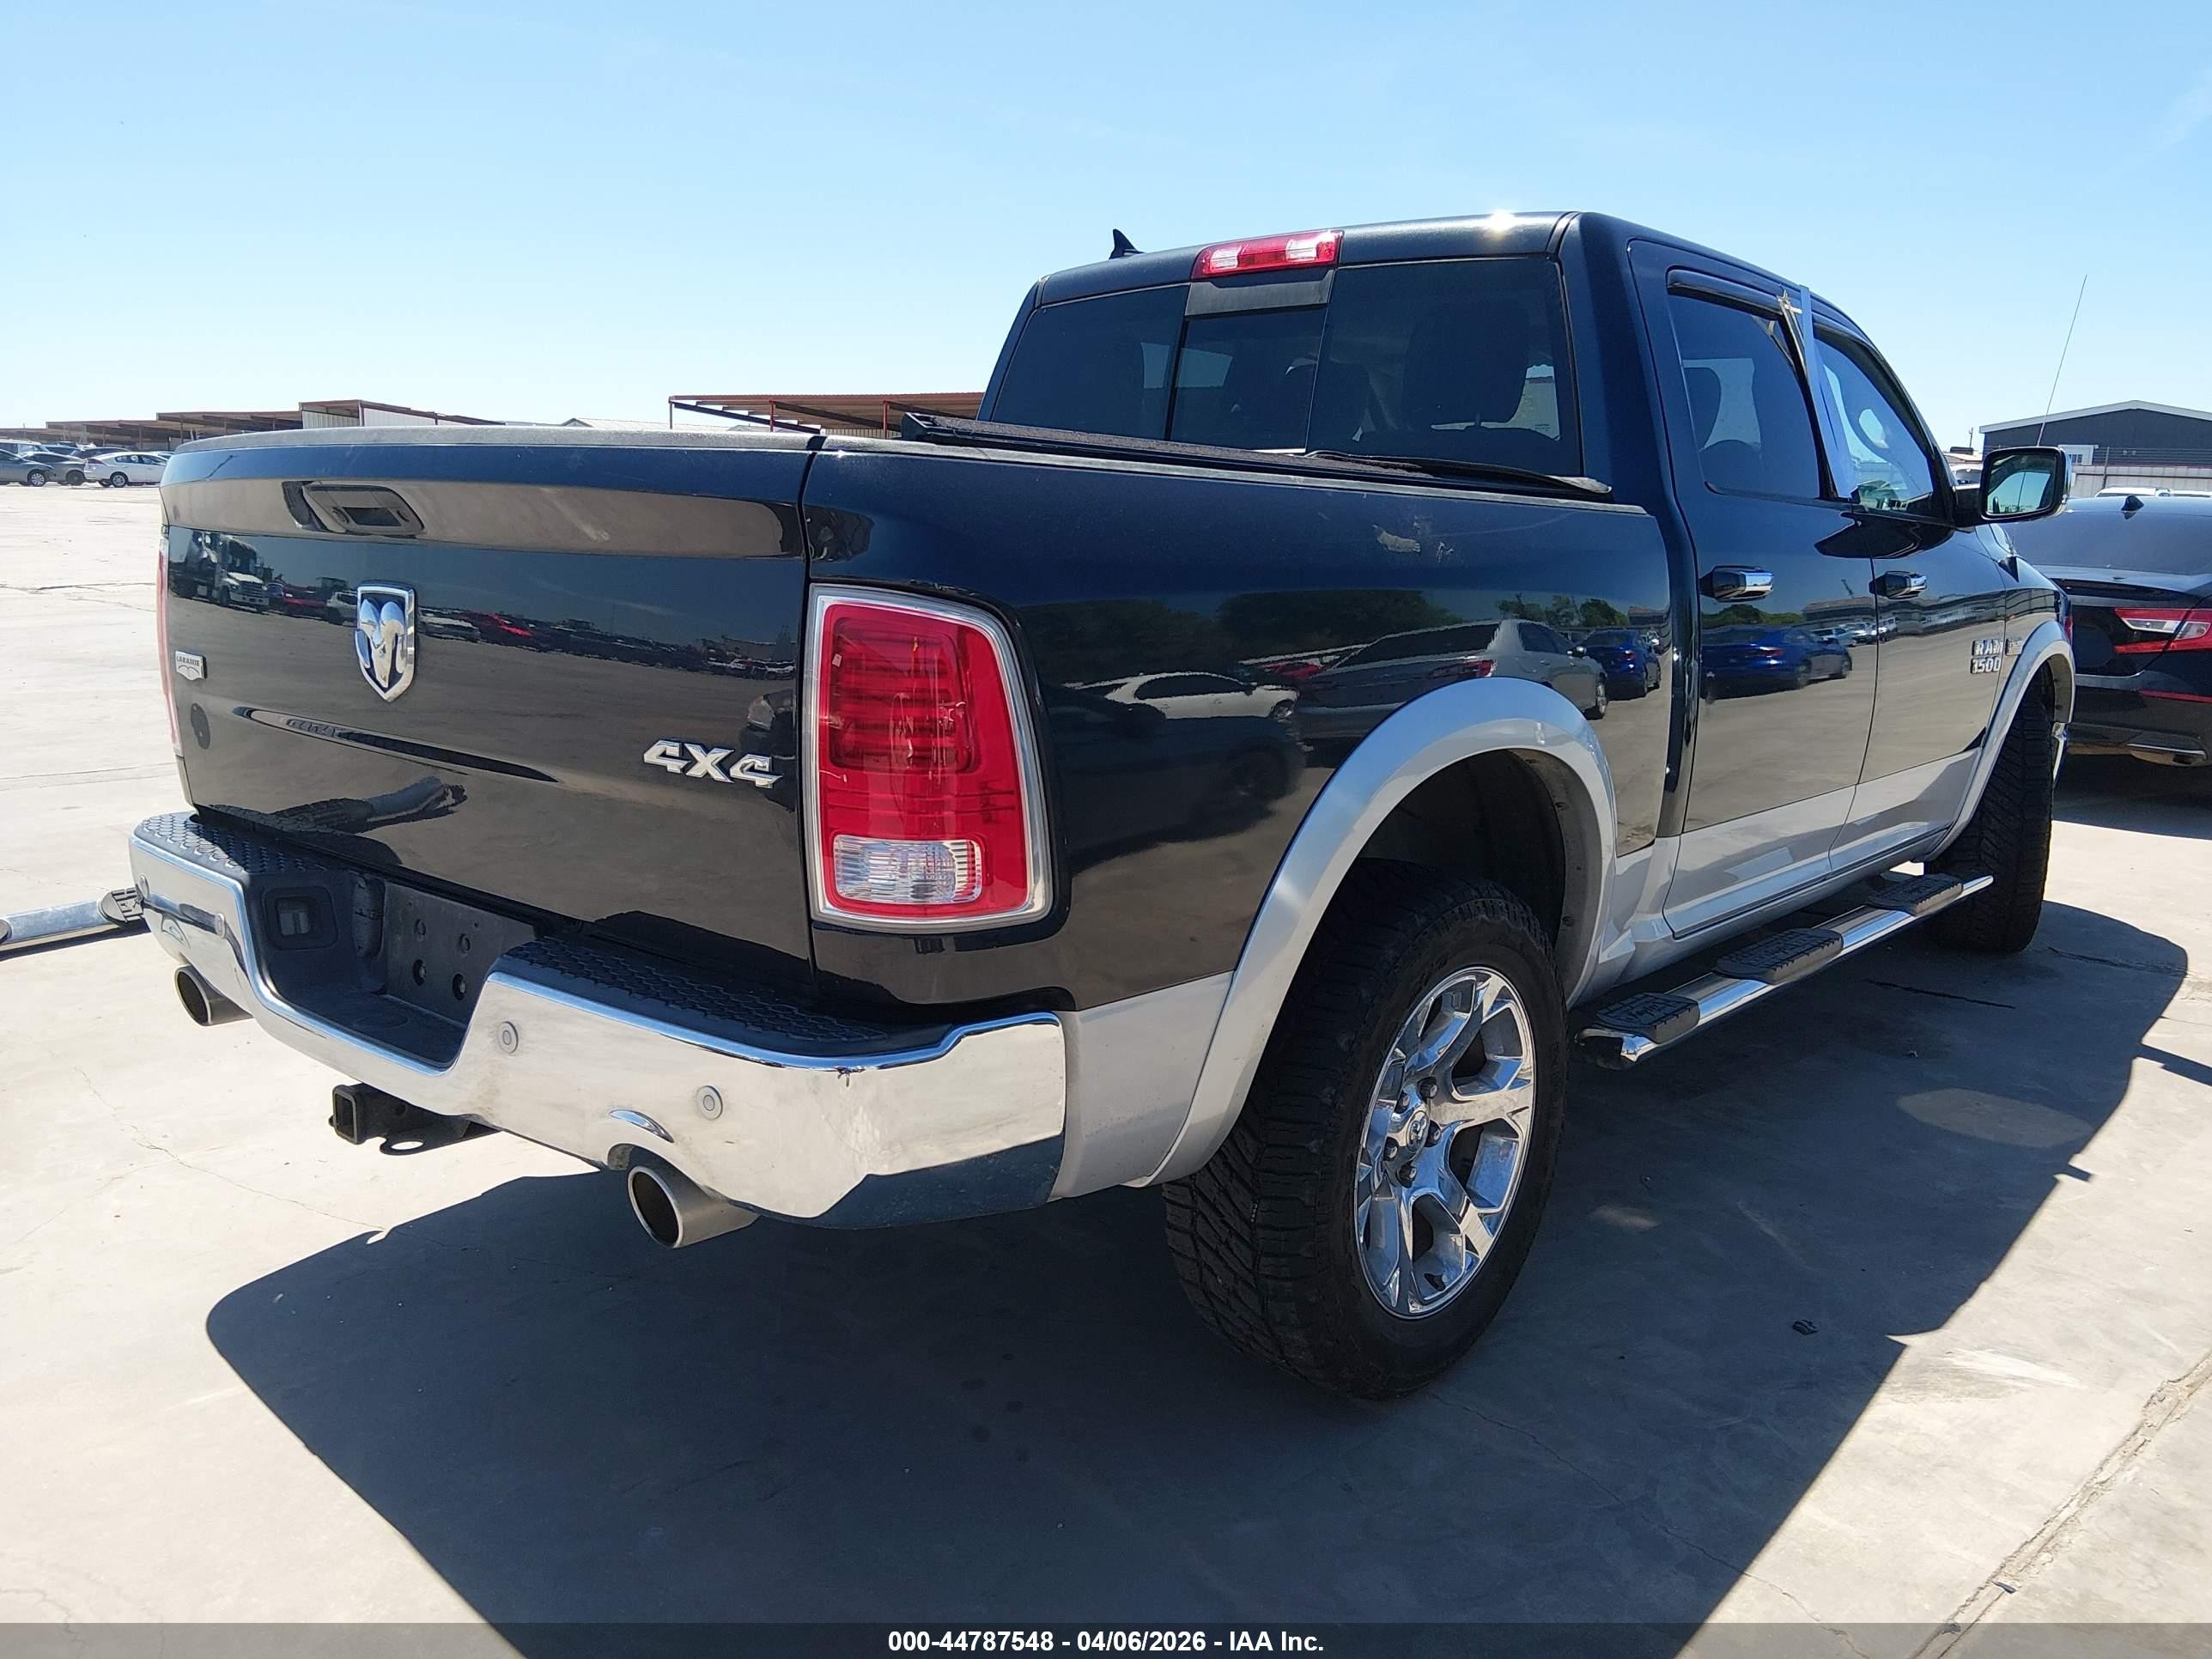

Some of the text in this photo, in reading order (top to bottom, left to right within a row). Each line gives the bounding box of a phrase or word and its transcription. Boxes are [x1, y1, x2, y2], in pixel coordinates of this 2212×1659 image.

[1972, 639, 2003, 655] RAM
[176, 655, 200, 667] LARAMIE
[1972, 657, 2002, 674] 1500
